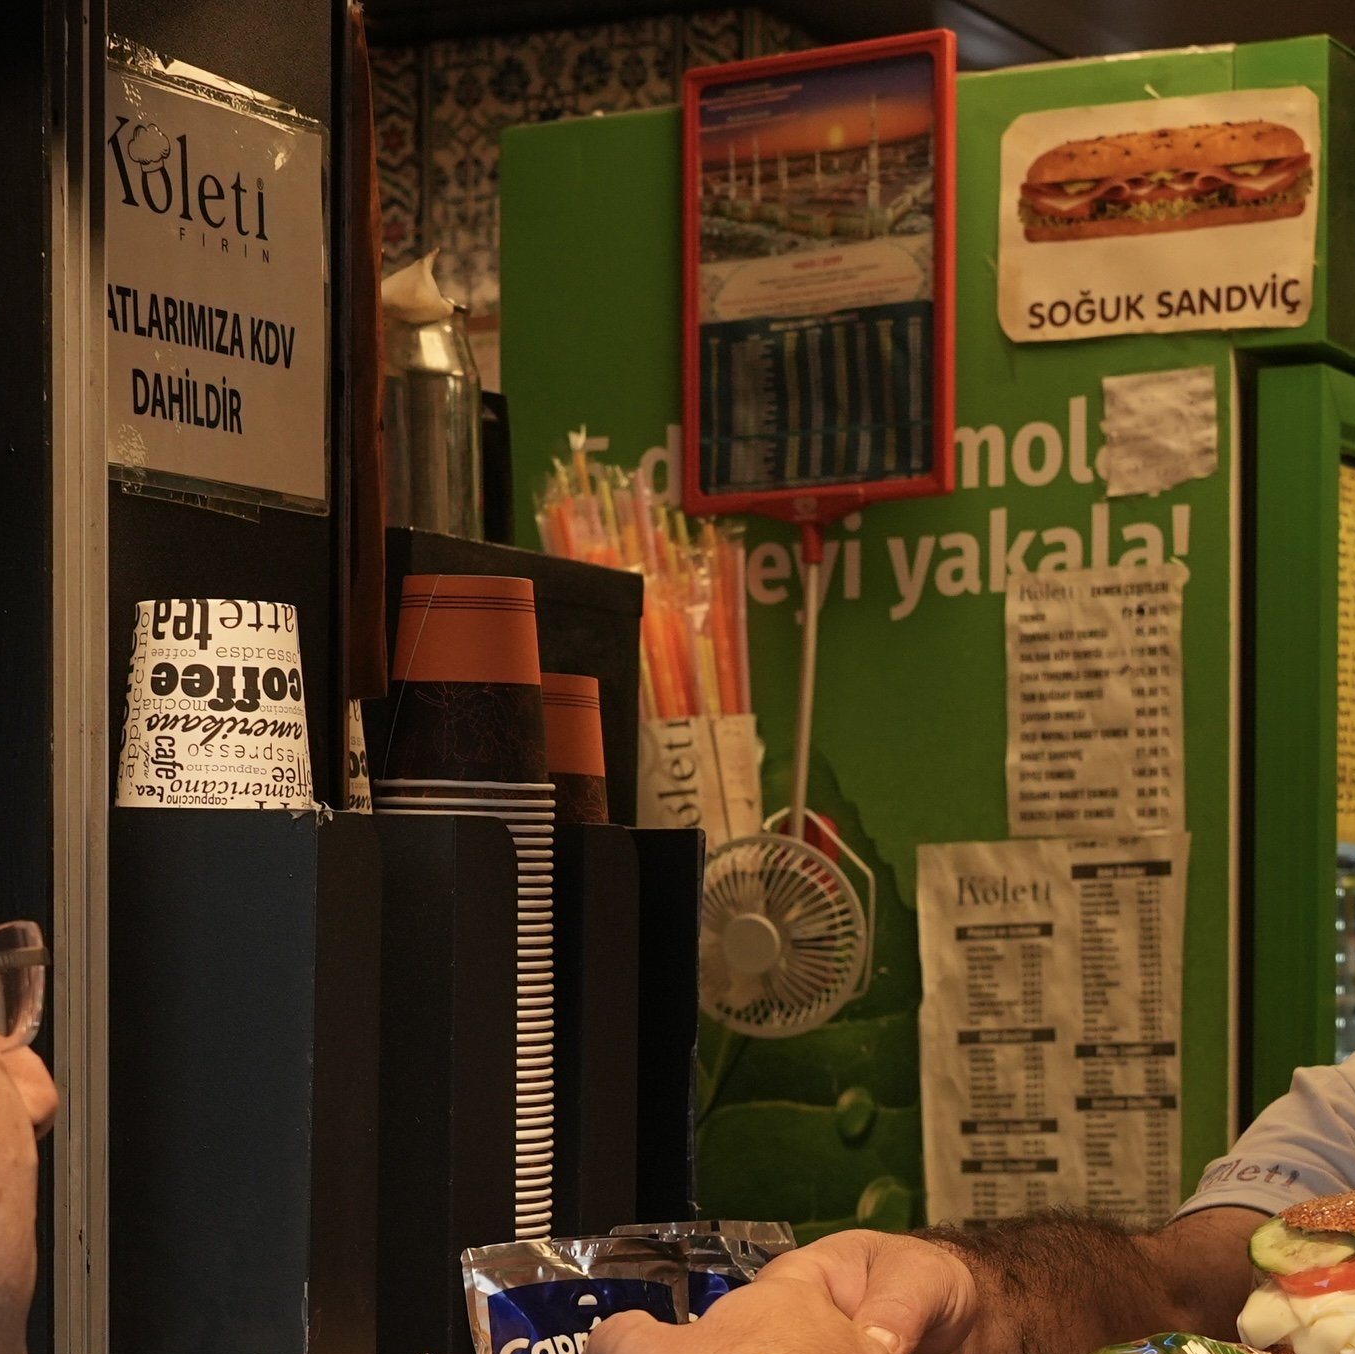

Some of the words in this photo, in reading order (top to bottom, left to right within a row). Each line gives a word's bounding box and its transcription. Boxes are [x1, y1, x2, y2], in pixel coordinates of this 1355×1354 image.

[179, 227, 270, 264] FIRIN
[107, 283, 245, 359] ATLARIMIZA
[250, 316, 295, 369] KDV
[1028, 290, 1144, 330] SOĞUK
[1156, 273, 1301, 319] SANDVİÇ
[132, 367, 242, 435] DAHİLDİR
[954, 395, 1108, 490] mol
[152, 599, 212, 650] tea
[219, 599, 300, 634] atte
[126, 611, 151, 779] appuccino
[150, 662, 302, 712] coffee
[146, 713, 303, 747] amerikano
[171, 780, 295, 798] americano
[186, 763, 268, 776] cappuccino
[658, 720, 703, 828] oleti
